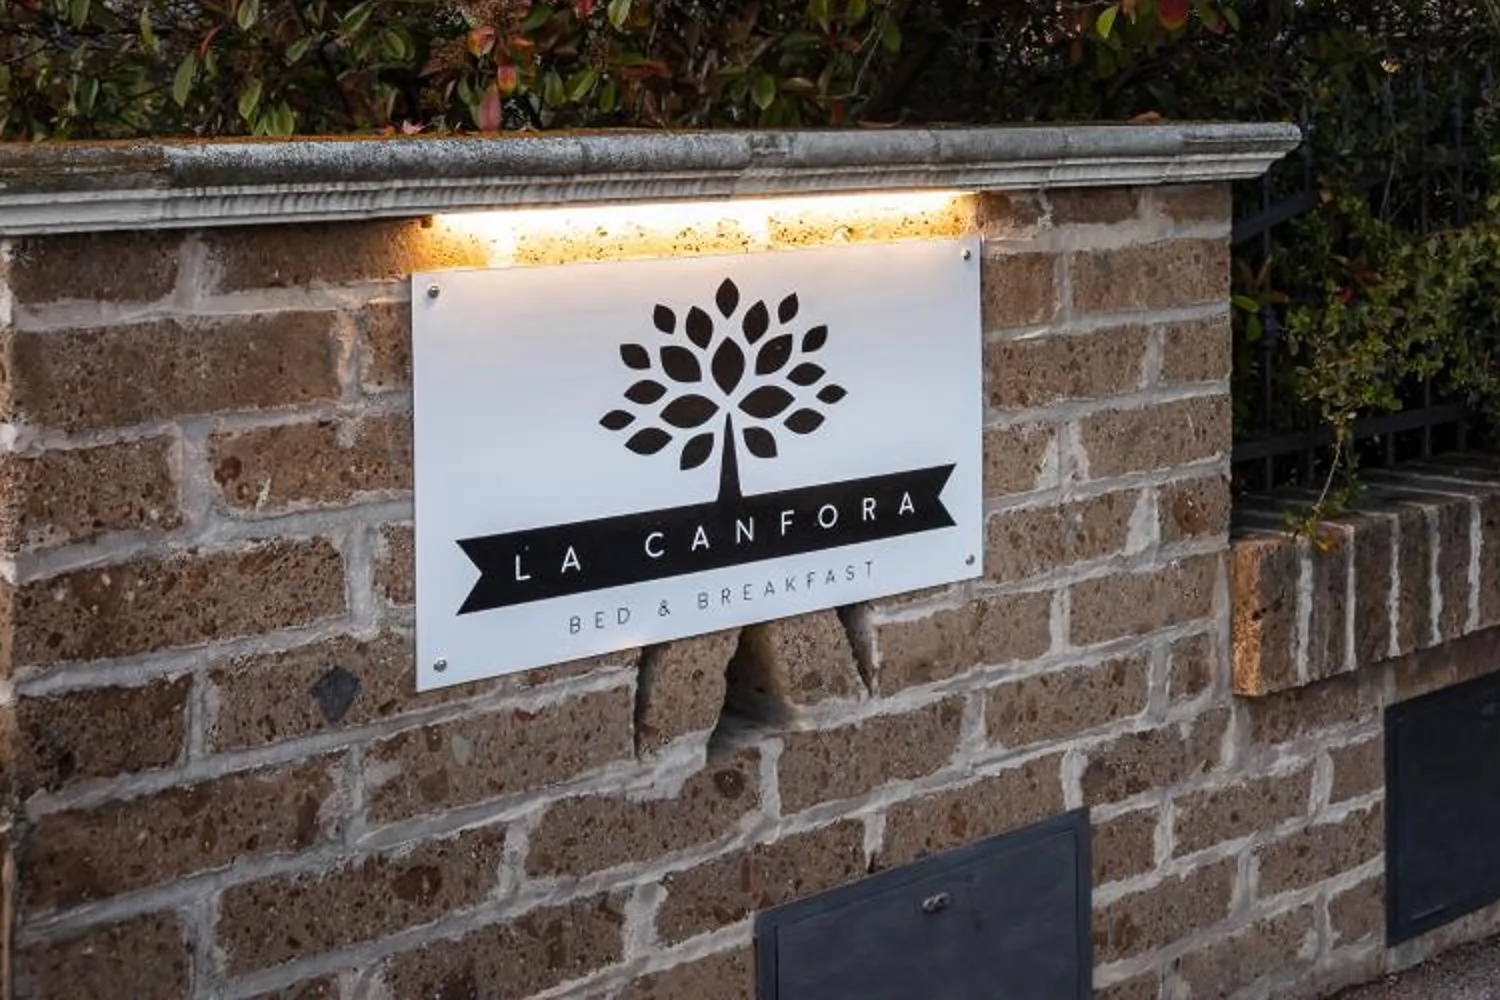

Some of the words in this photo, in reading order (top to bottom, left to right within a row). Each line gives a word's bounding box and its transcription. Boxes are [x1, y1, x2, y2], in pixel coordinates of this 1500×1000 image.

[514, 545, 582, 581] LA
[644, 491, 916, 558] CANFORA
[568, 607, 631, 635] BED
[656, 600, 672, 617] &
[697, 560, 875, 611] BREAKFAST
